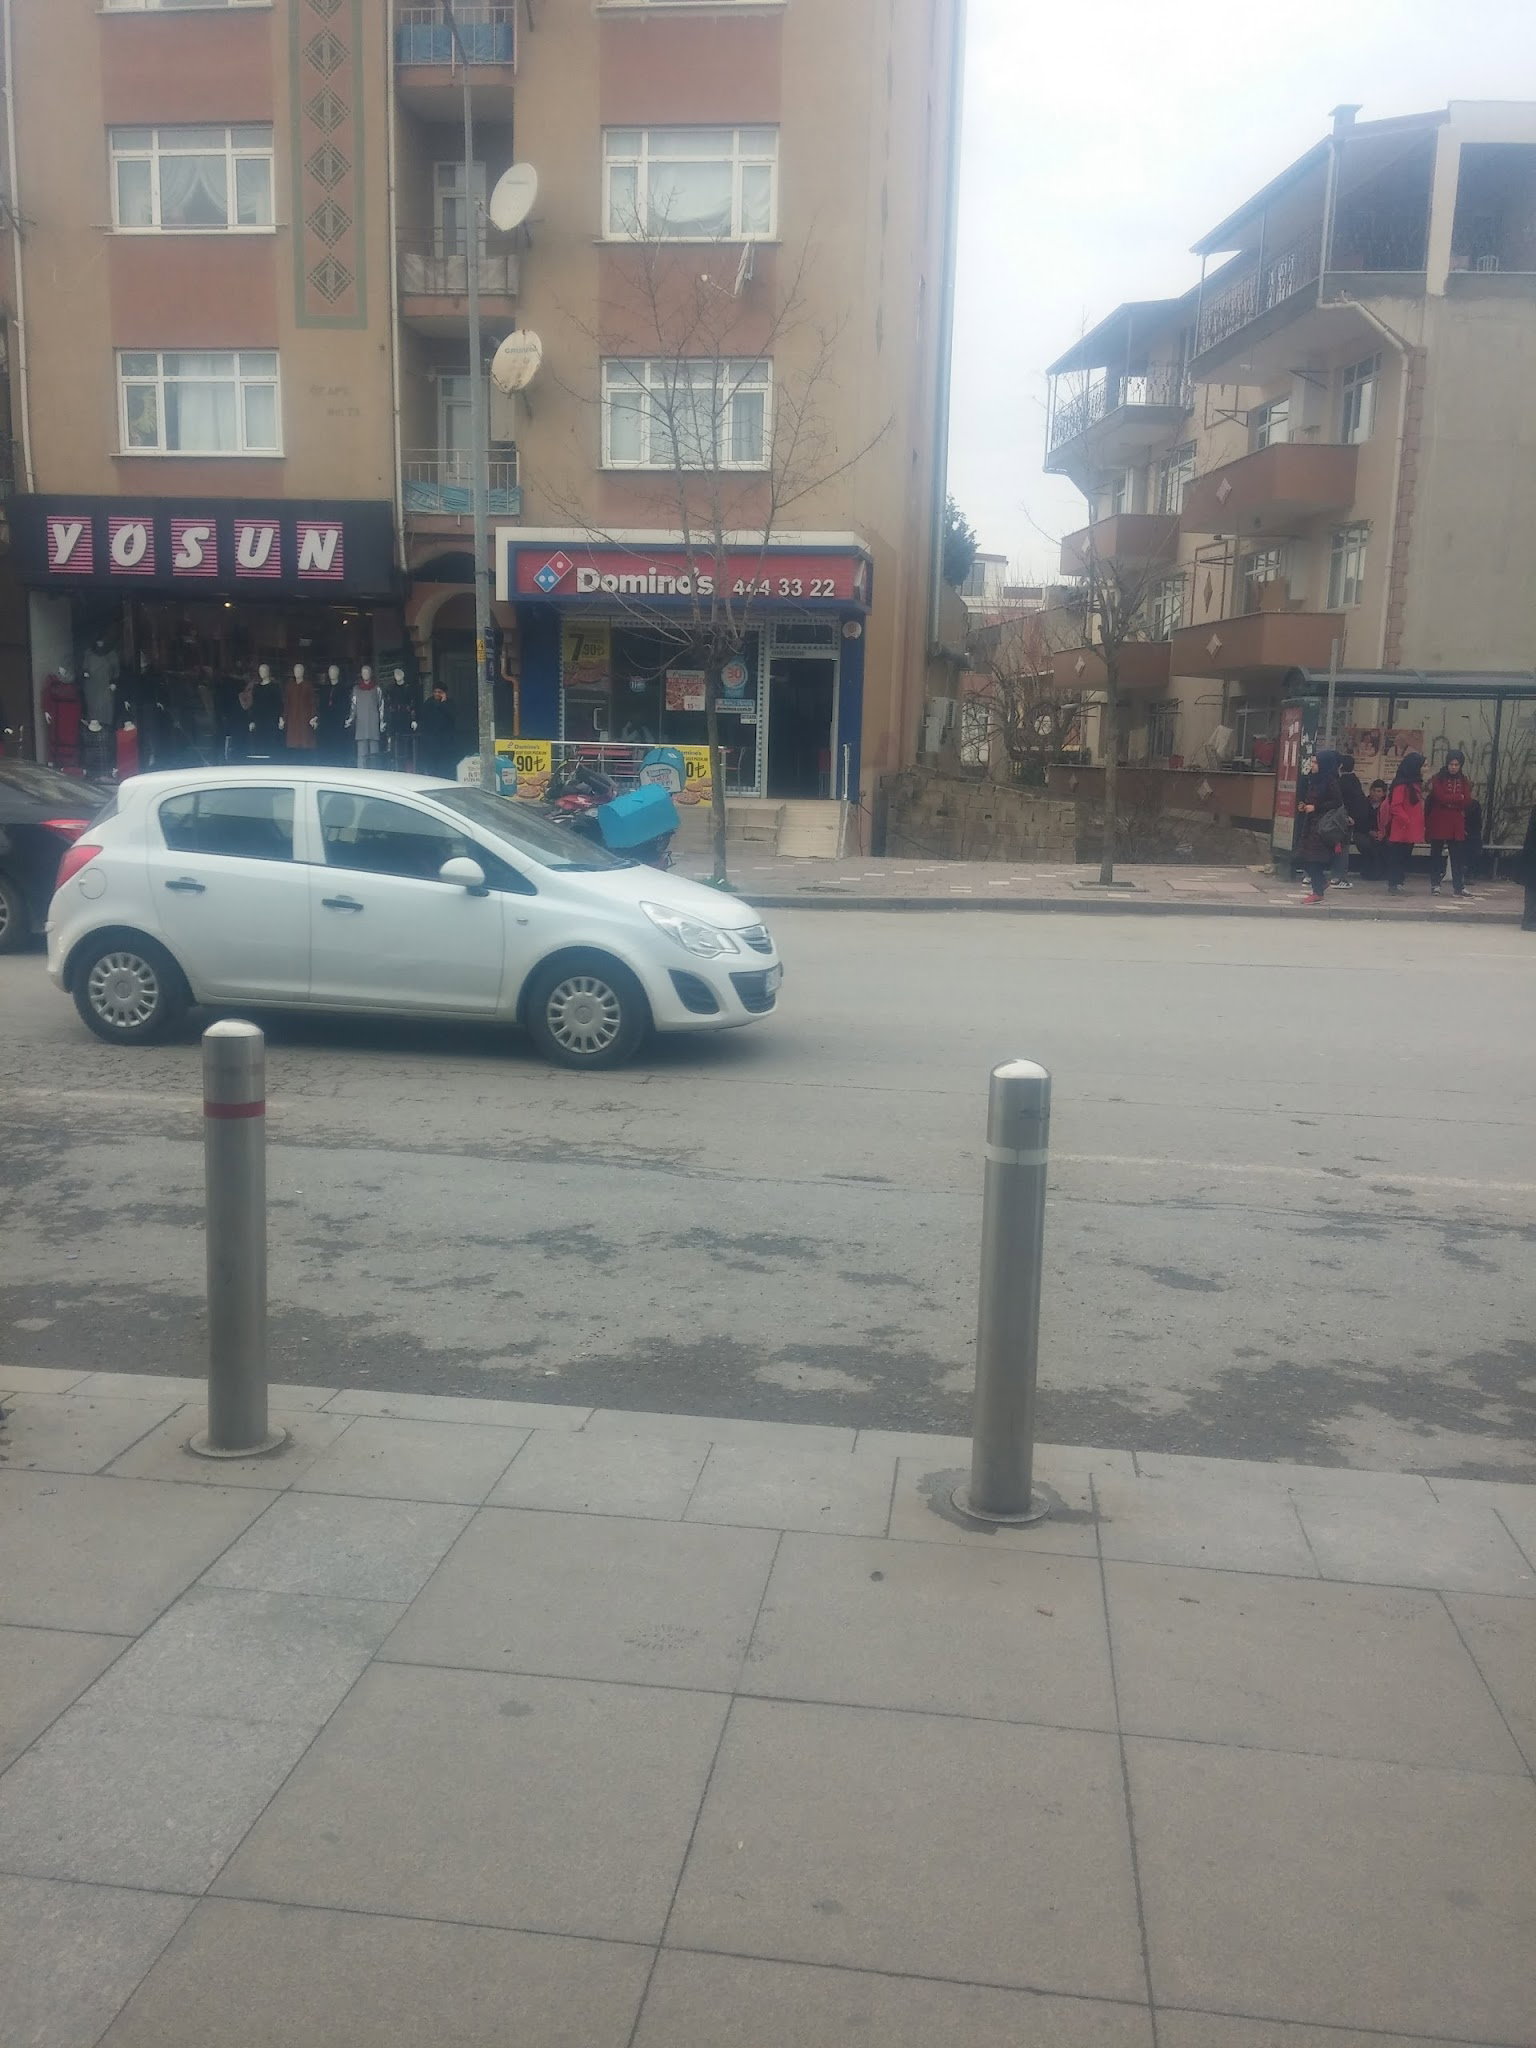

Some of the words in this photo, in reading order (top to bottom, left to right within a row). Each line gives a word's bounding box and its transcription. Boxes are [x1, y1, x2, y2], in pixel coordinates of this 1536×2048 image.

[52, 523, 340, 571] YOSUN
[576, 566, 714, 595] Domino's
[732, 579, 770, 596] 444
[778, 578, 802, 596] 33
[809, 579, 835, 597] 22
[568, 633, 585, 661] 7
